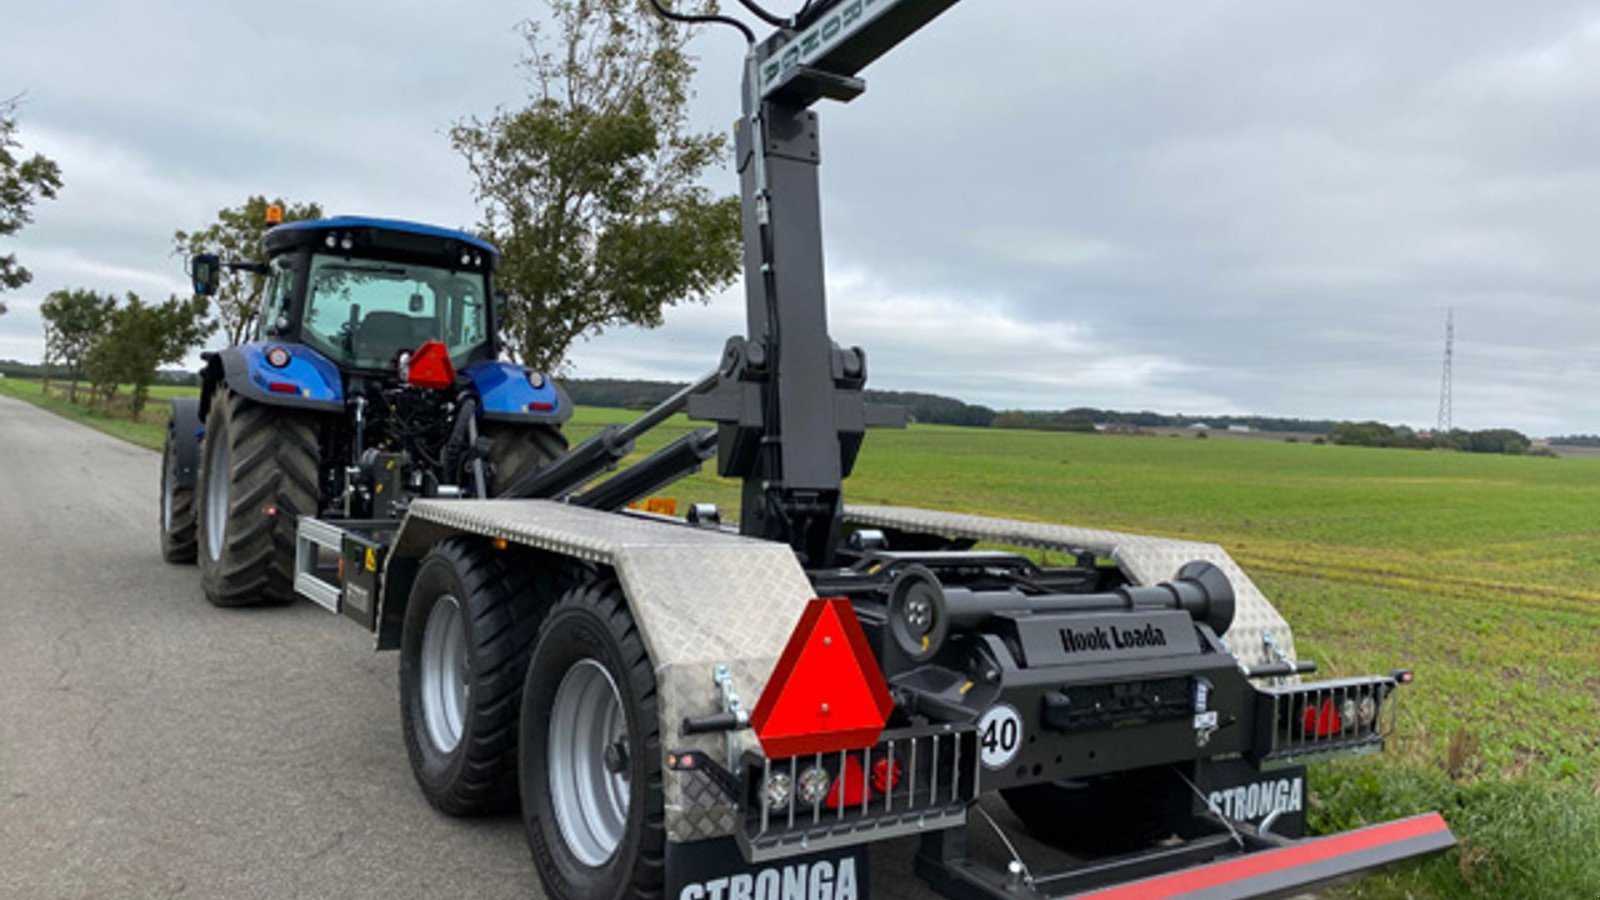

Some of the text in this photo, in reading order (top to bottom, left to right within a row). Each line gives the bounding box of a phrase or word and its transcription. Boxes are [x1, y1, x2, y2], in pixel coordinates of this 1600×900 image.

[763, 0, 873, 86] RONGA
[1059, 623, 1166, 652] Hook Loada
[981, 717, 1017, 752] 40
[1208, 777, 1303, 821] STRONGA
